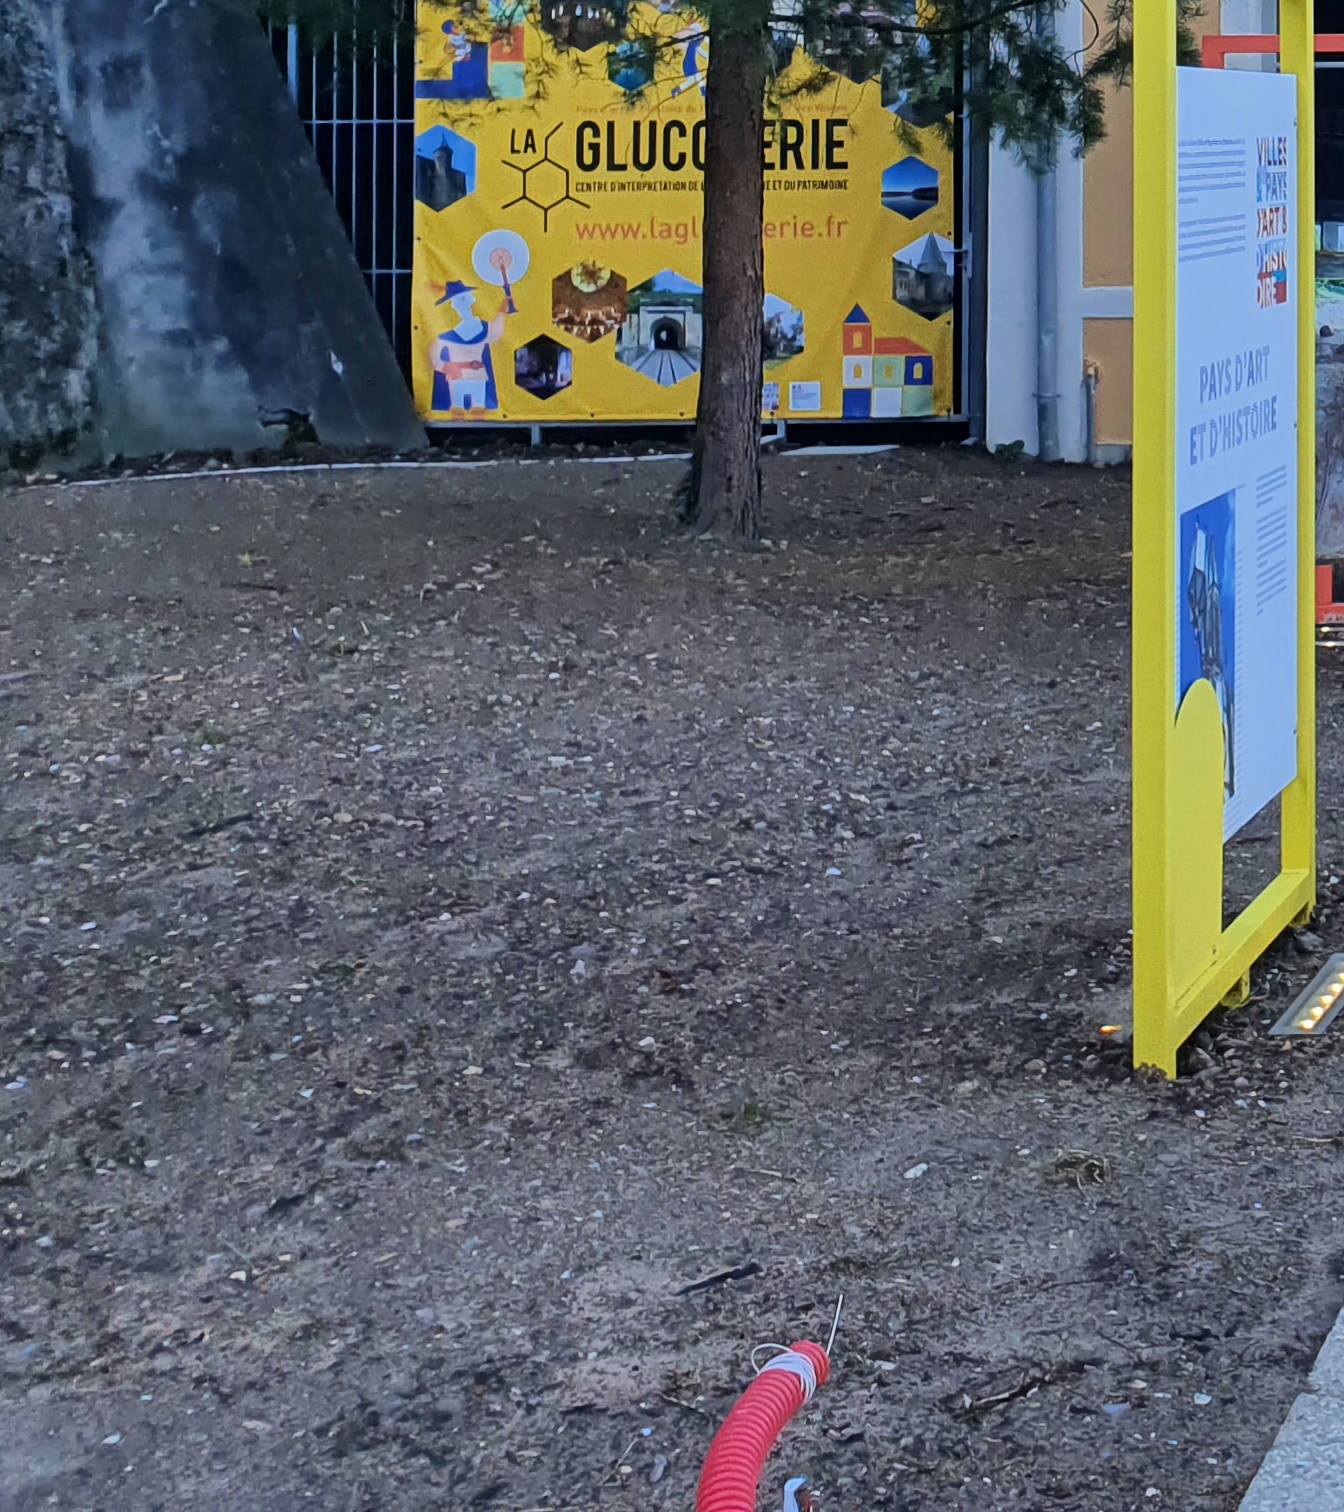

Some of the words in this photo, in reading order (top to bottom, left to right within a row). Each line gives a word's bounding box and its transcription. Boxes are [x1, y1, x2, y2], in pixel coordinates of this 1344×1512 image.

[511, 127, 537, 154] LA
[575, 180, 608, 193] CENTRE
[688, 179, 699, 191] DE
[773, 179, 782, 191] ET
[784, 179, 796, 191] DU
[797, 179, 848, 190] PATRIMOINE
[1199, 358, 1232, 405] PAYS
[1234, 345, 1270, 392] D'ART
[1189, 421, 1207, 466] ET
[1208, 395, 1278, 458] D'HISTOIRE
